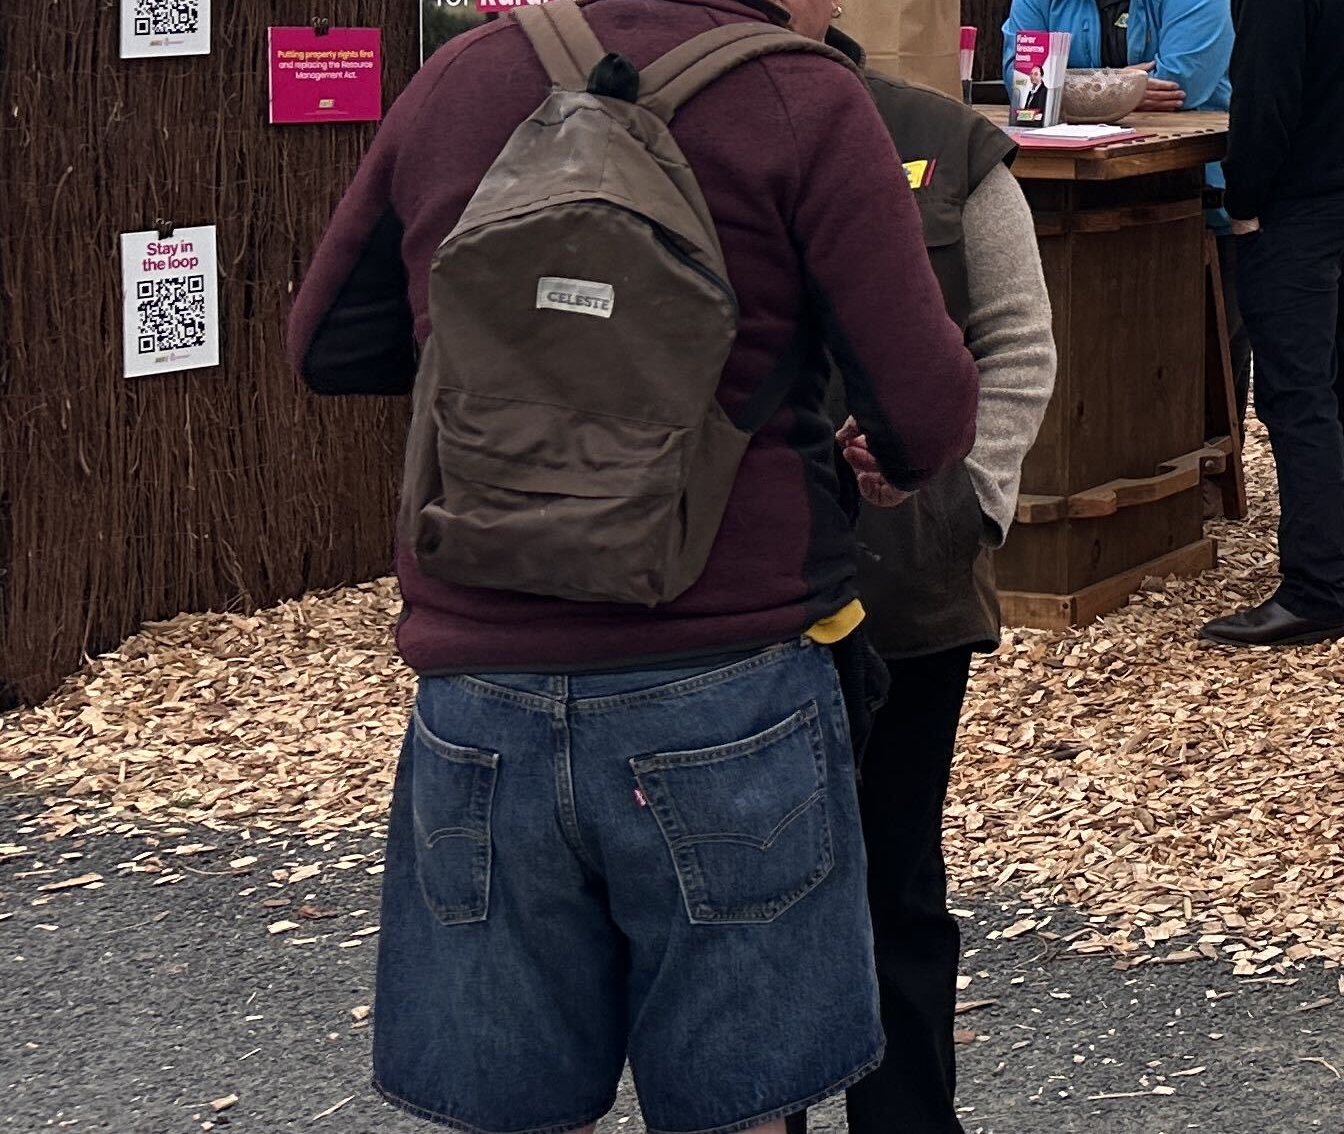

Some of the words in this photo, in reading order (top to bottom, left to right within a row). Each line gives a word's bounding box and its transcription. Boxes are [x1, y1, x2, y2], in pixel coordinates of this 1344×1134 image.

[146, 242, 178, 257] Stay
[180, 240, 193, 253] in
[142, 257, 166, 272] the
[168, 256, 199, 270] loop
[546, 291, 610, 311] CELESTE
